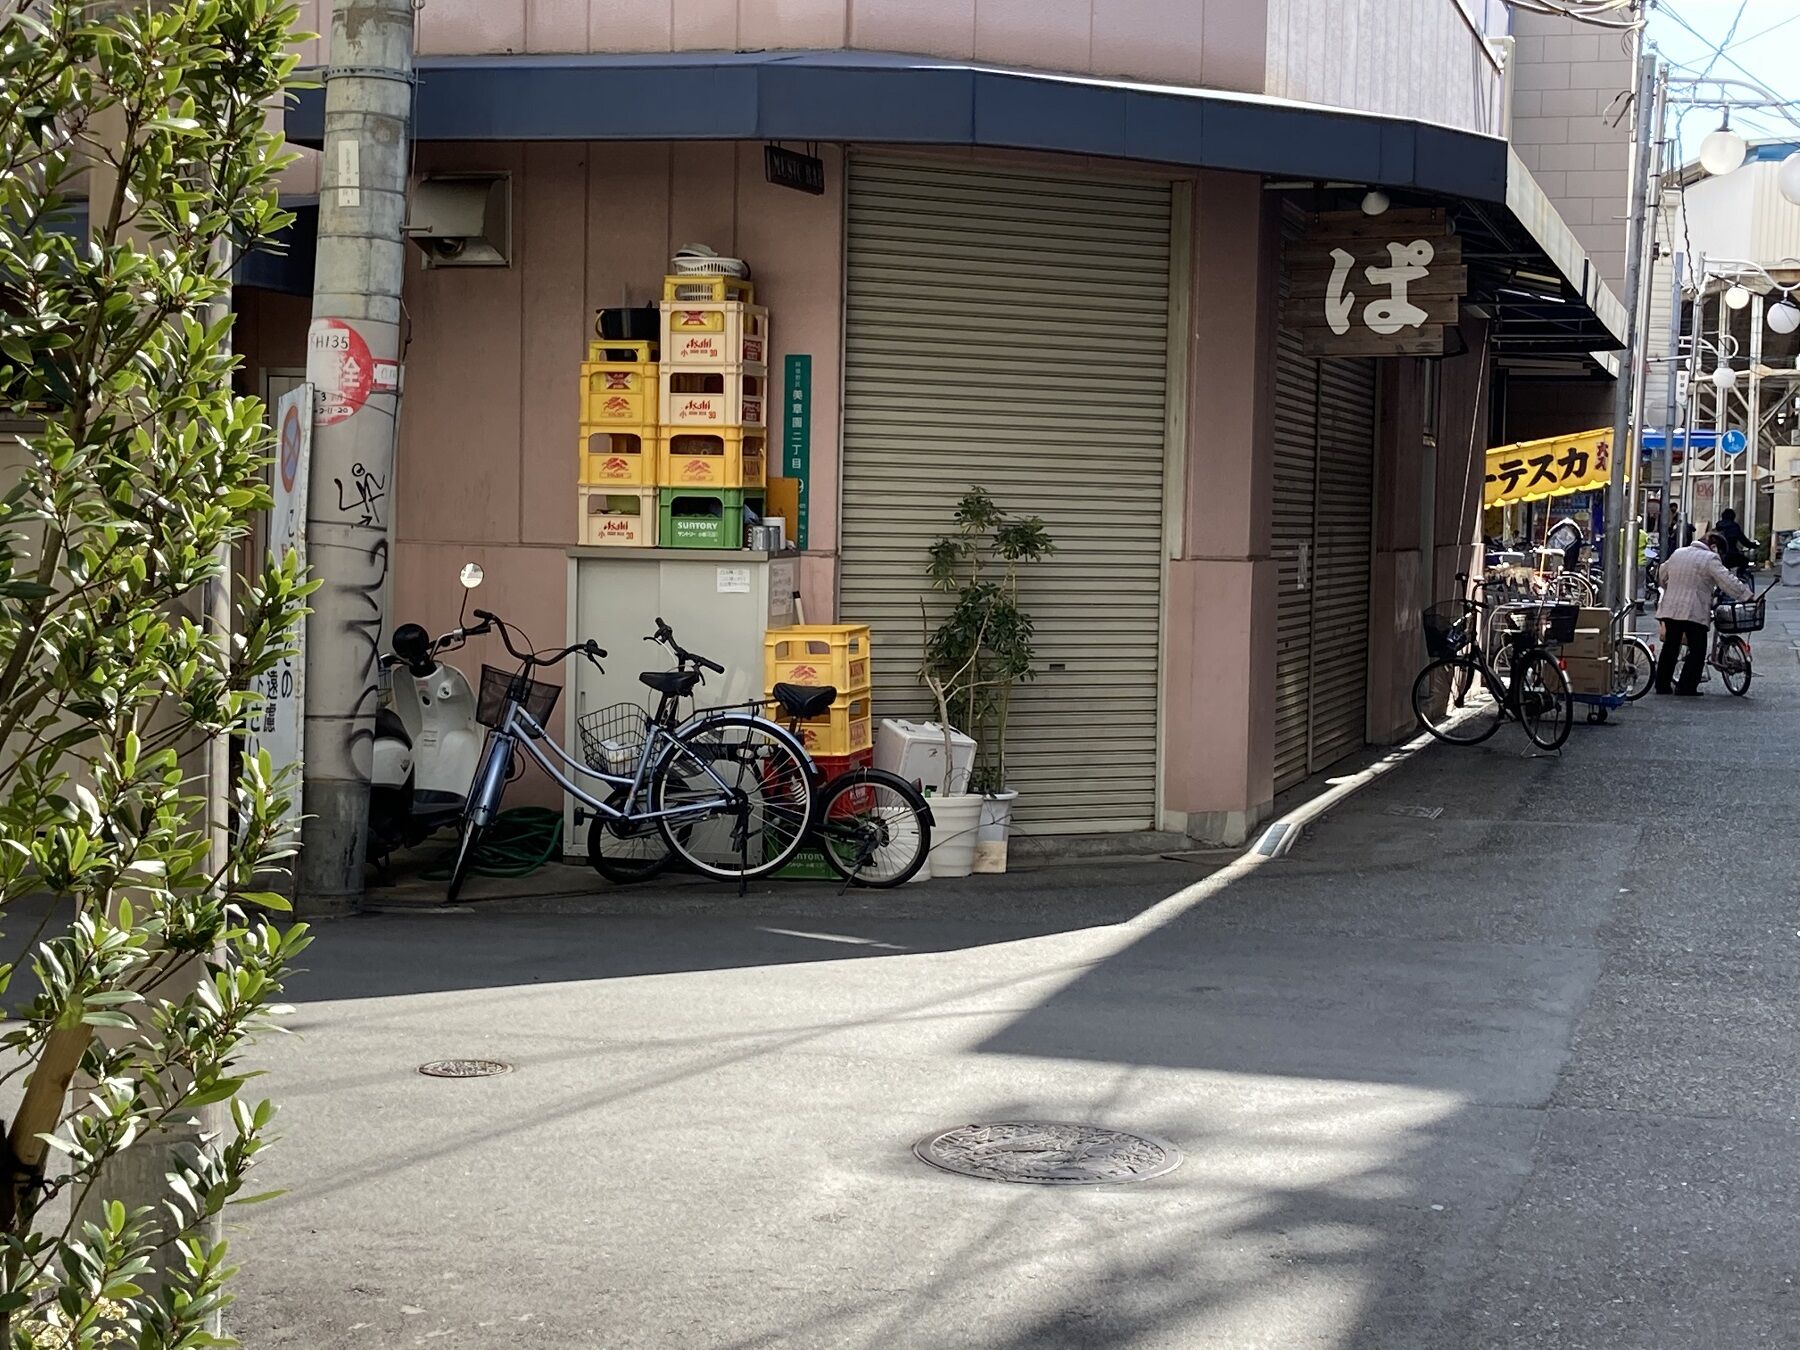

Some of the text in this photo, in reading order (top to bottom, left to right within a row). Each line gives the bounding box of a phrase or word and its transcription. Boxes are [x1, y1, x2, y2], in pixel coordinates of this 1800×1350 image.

[1325, 239, 1434, 335] ぱ
[686, 338, 712, 348] Asahi
[685, 400, 711, 410] Asahi
[603, 520, 629, 531] Asahi
[677, 521, 718, 530] SUNTORY
